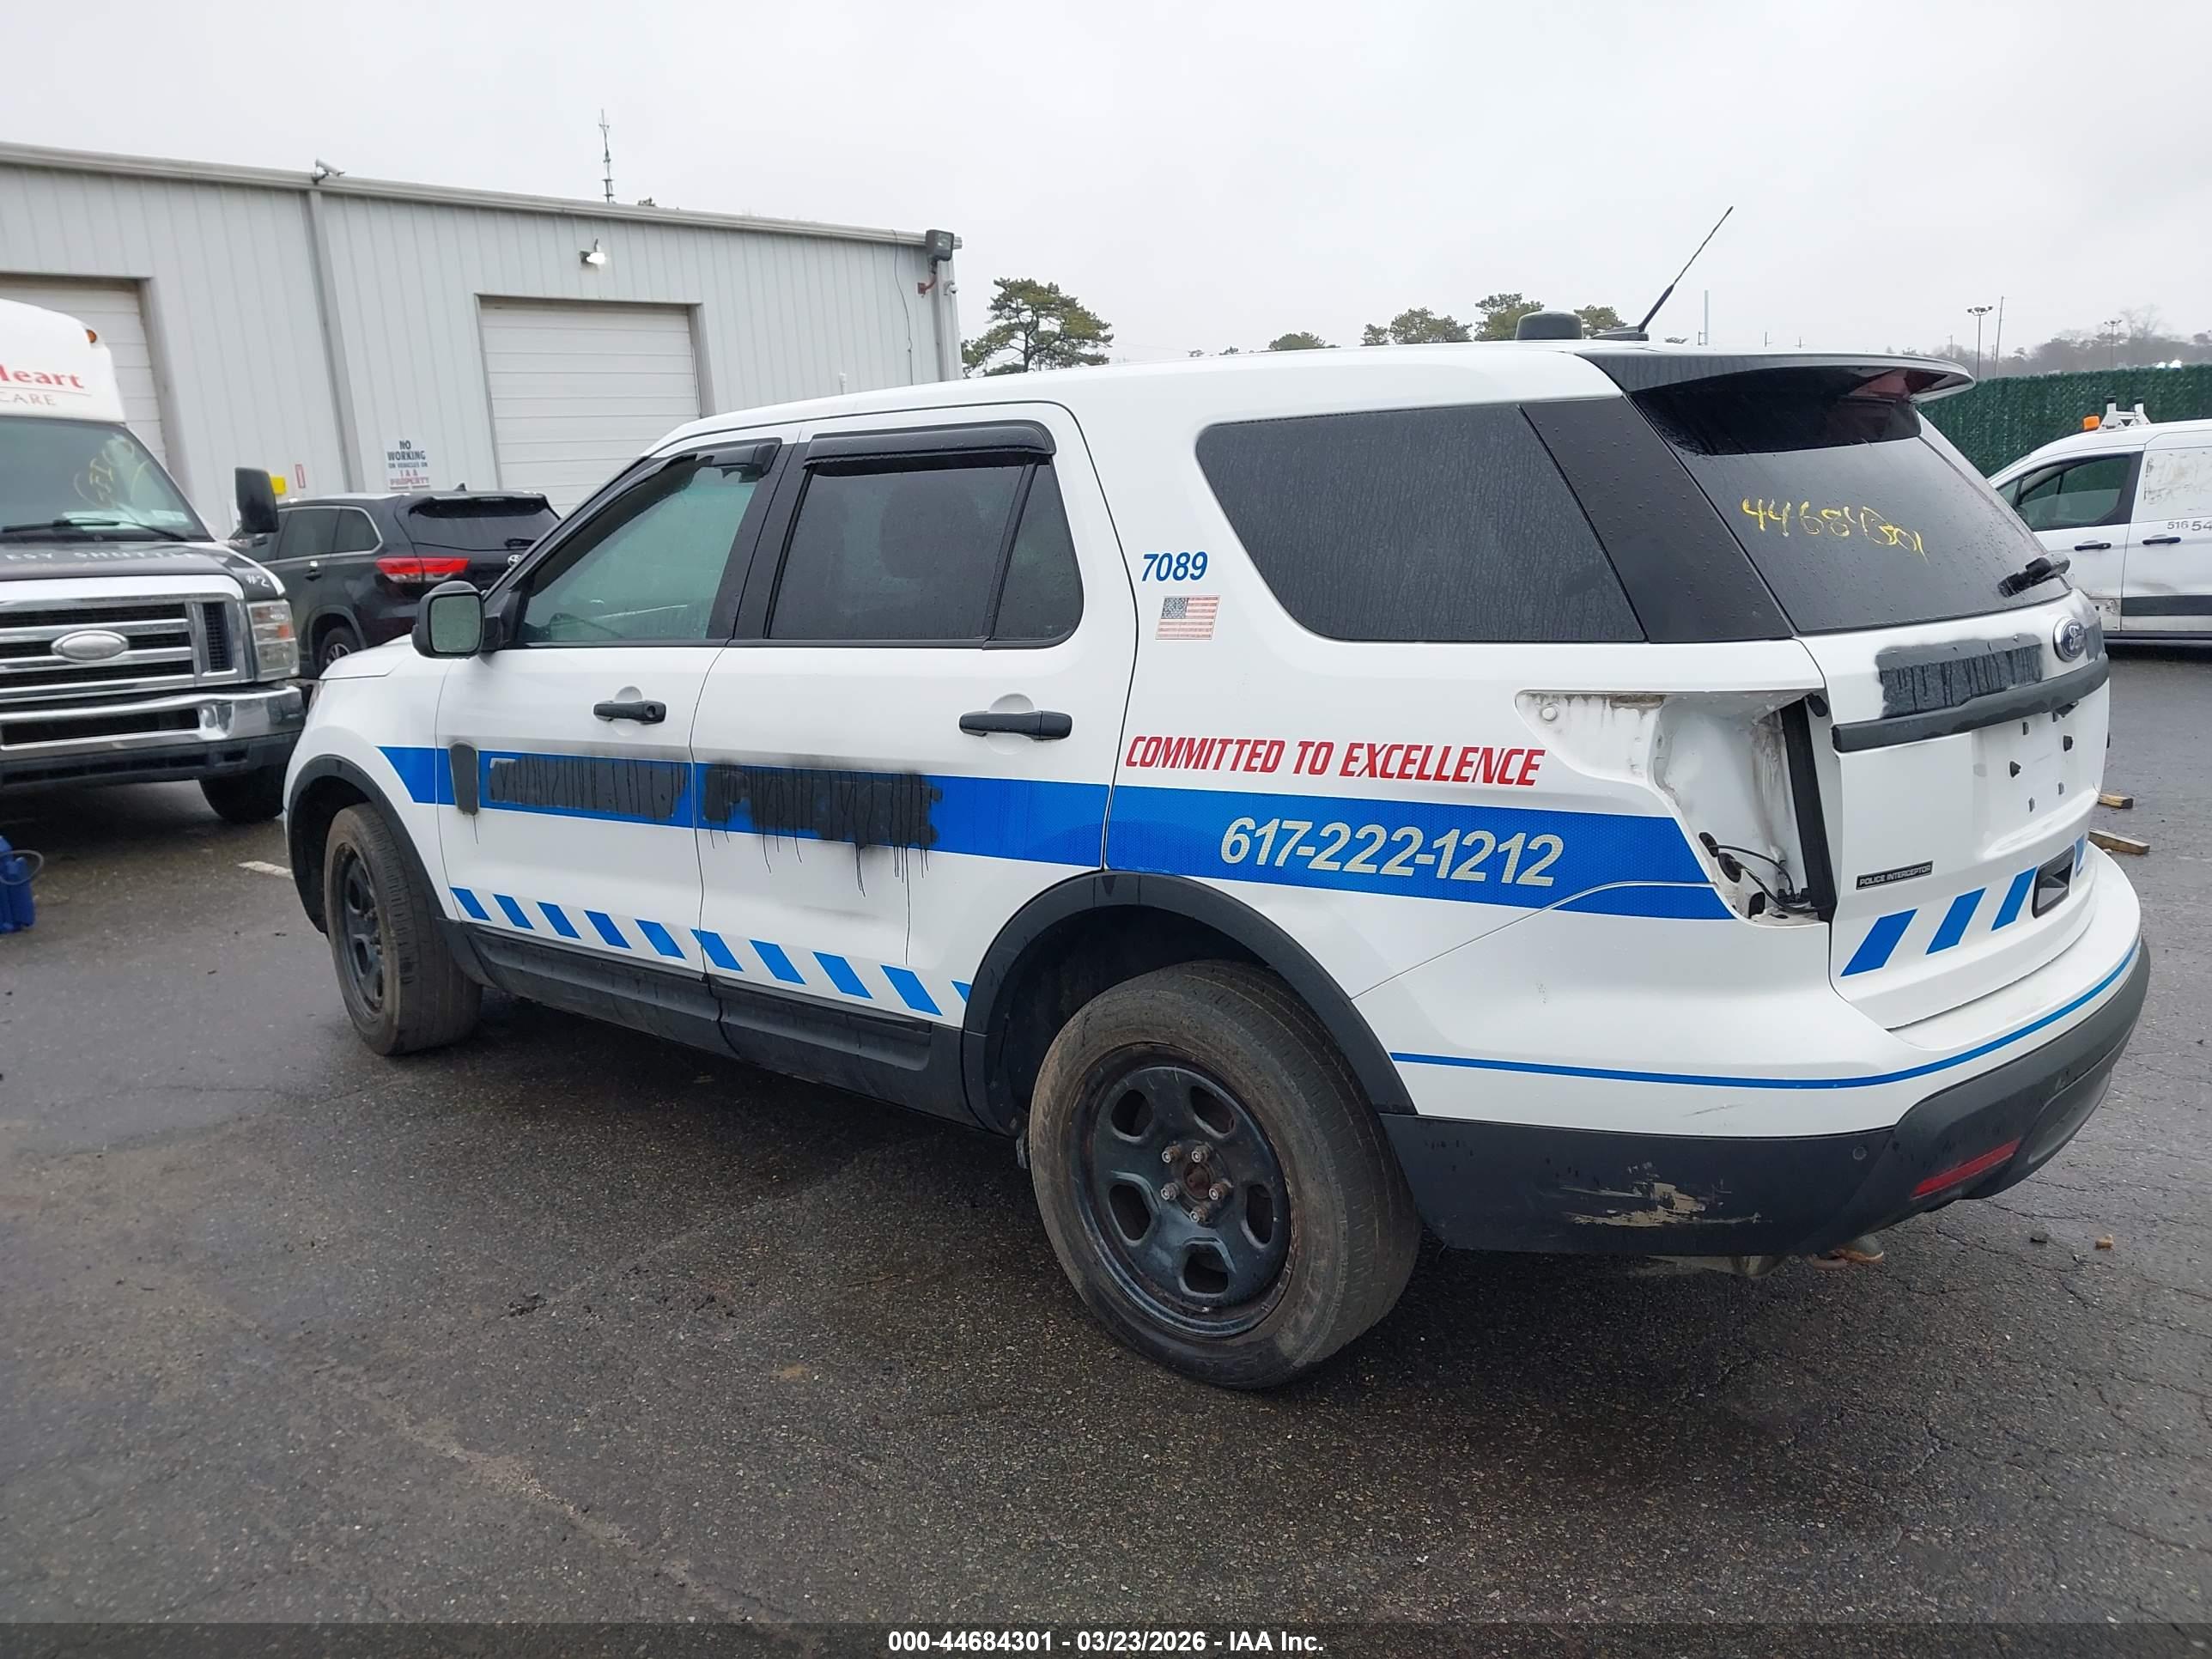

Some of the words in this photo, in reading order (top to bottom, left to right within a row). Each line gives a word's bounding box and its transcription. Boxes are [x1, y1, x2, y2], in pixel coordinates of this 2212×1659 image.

[387, 451, 426, 460] WORKING
[399, 440, 411, 450] NO
[2167, 521, 2189, 530] 516
[1141, 551, 1208, 581] 7089
[1126, 736, 1285, 774] COMMITTED
[1292, 741, 1335, 775] TO
[1338, 742, 1547, 787] EXCELLENCE
[1220, 816, 1565, 887] 617-222-1212
[1859, 874, 1886, 886] POLICE
[1887, 865, 1931, 881] INTERCEPTOR
